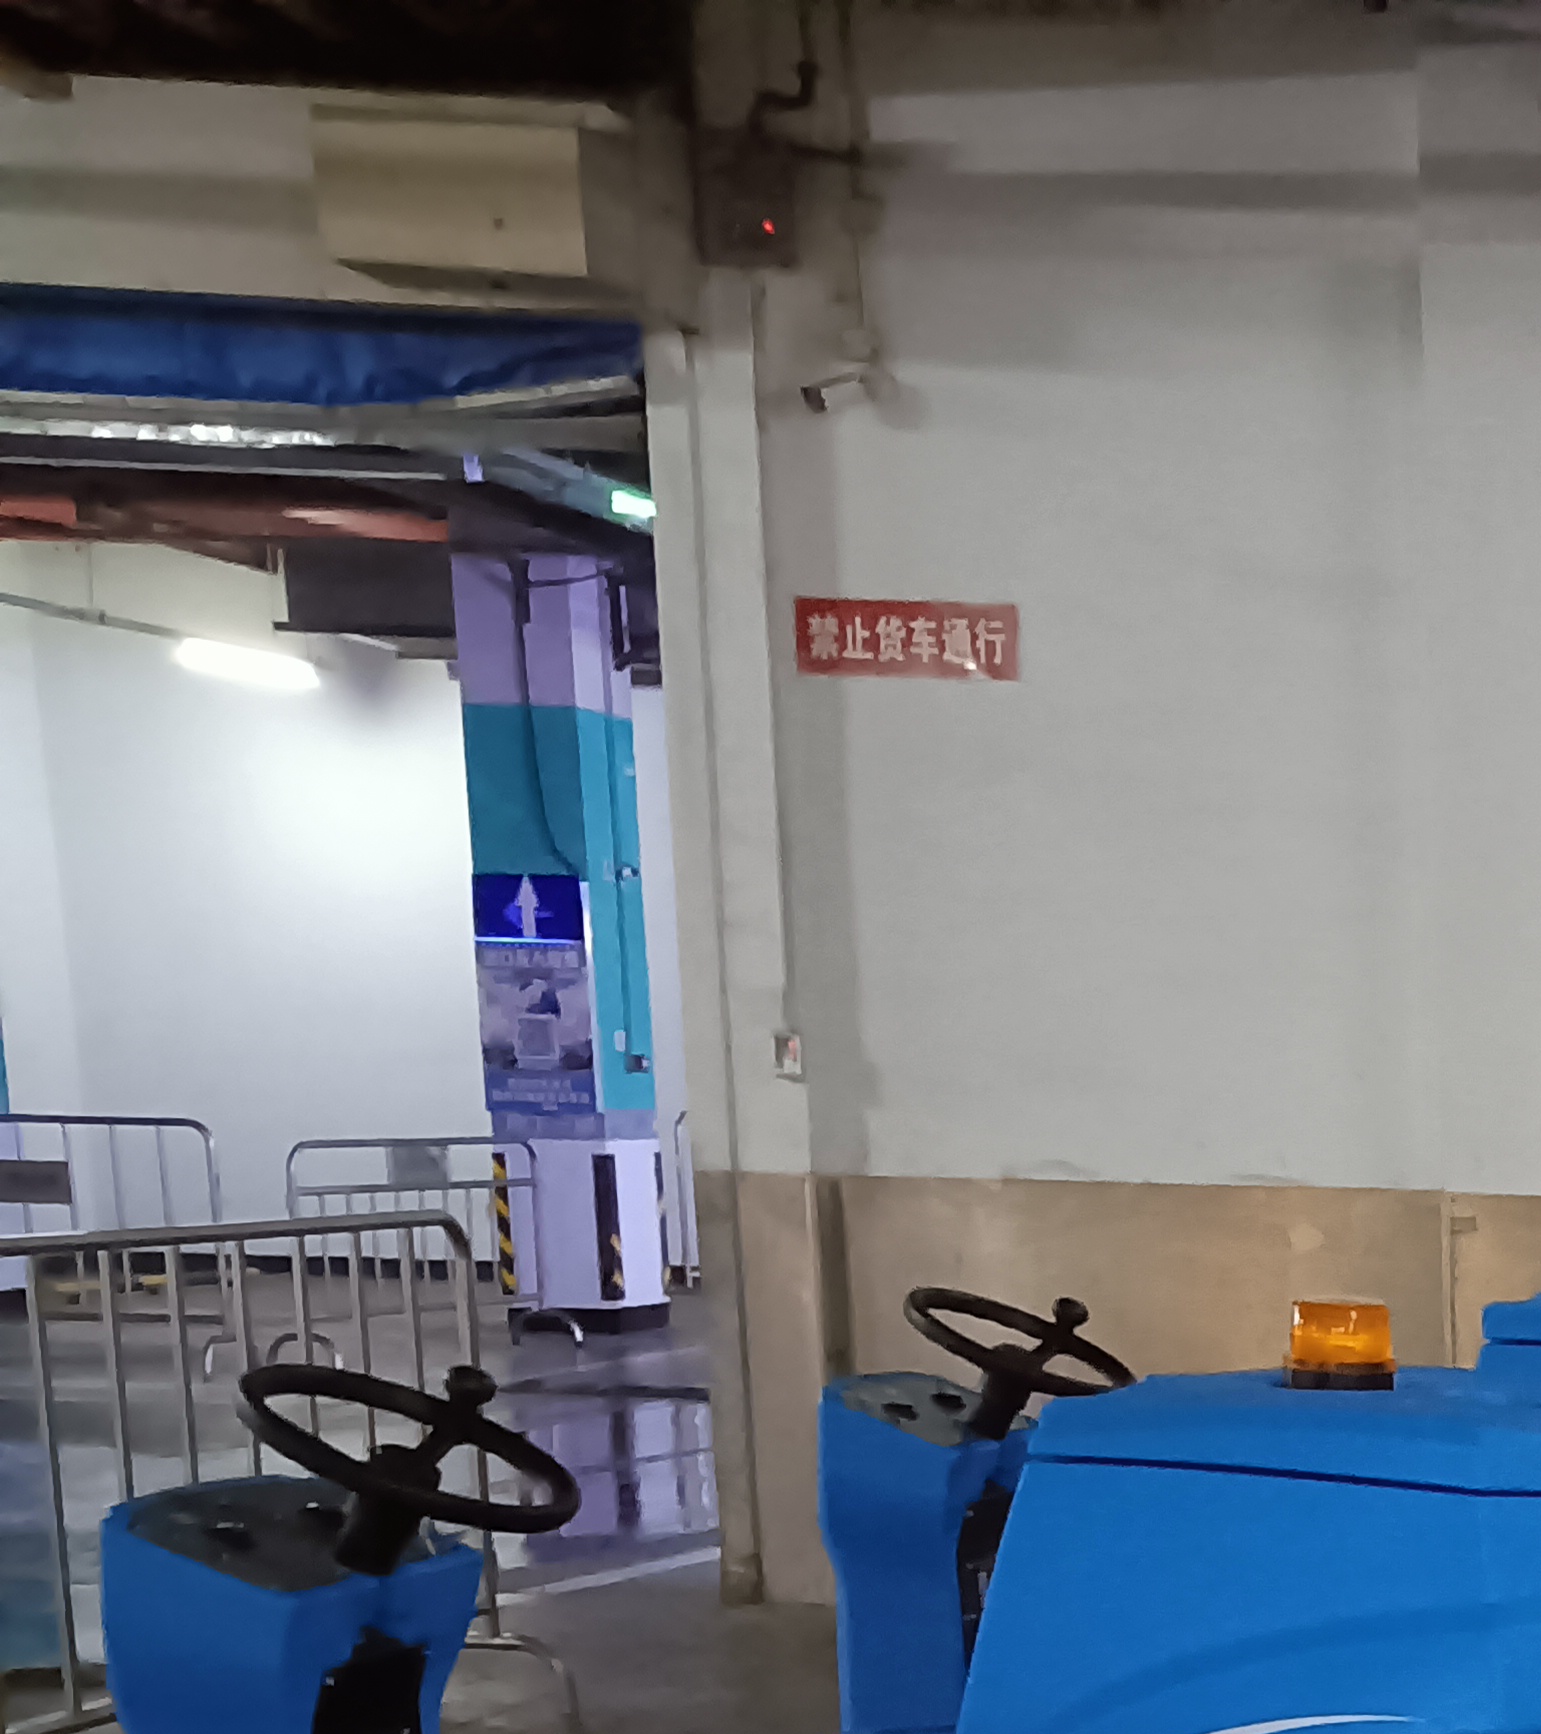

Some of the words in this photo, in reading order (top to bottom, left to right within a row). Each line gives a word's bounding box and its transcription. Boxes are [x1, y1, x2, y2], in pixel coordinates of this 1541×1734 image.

[807, 612, 1005, 665] 禁止货车通行
